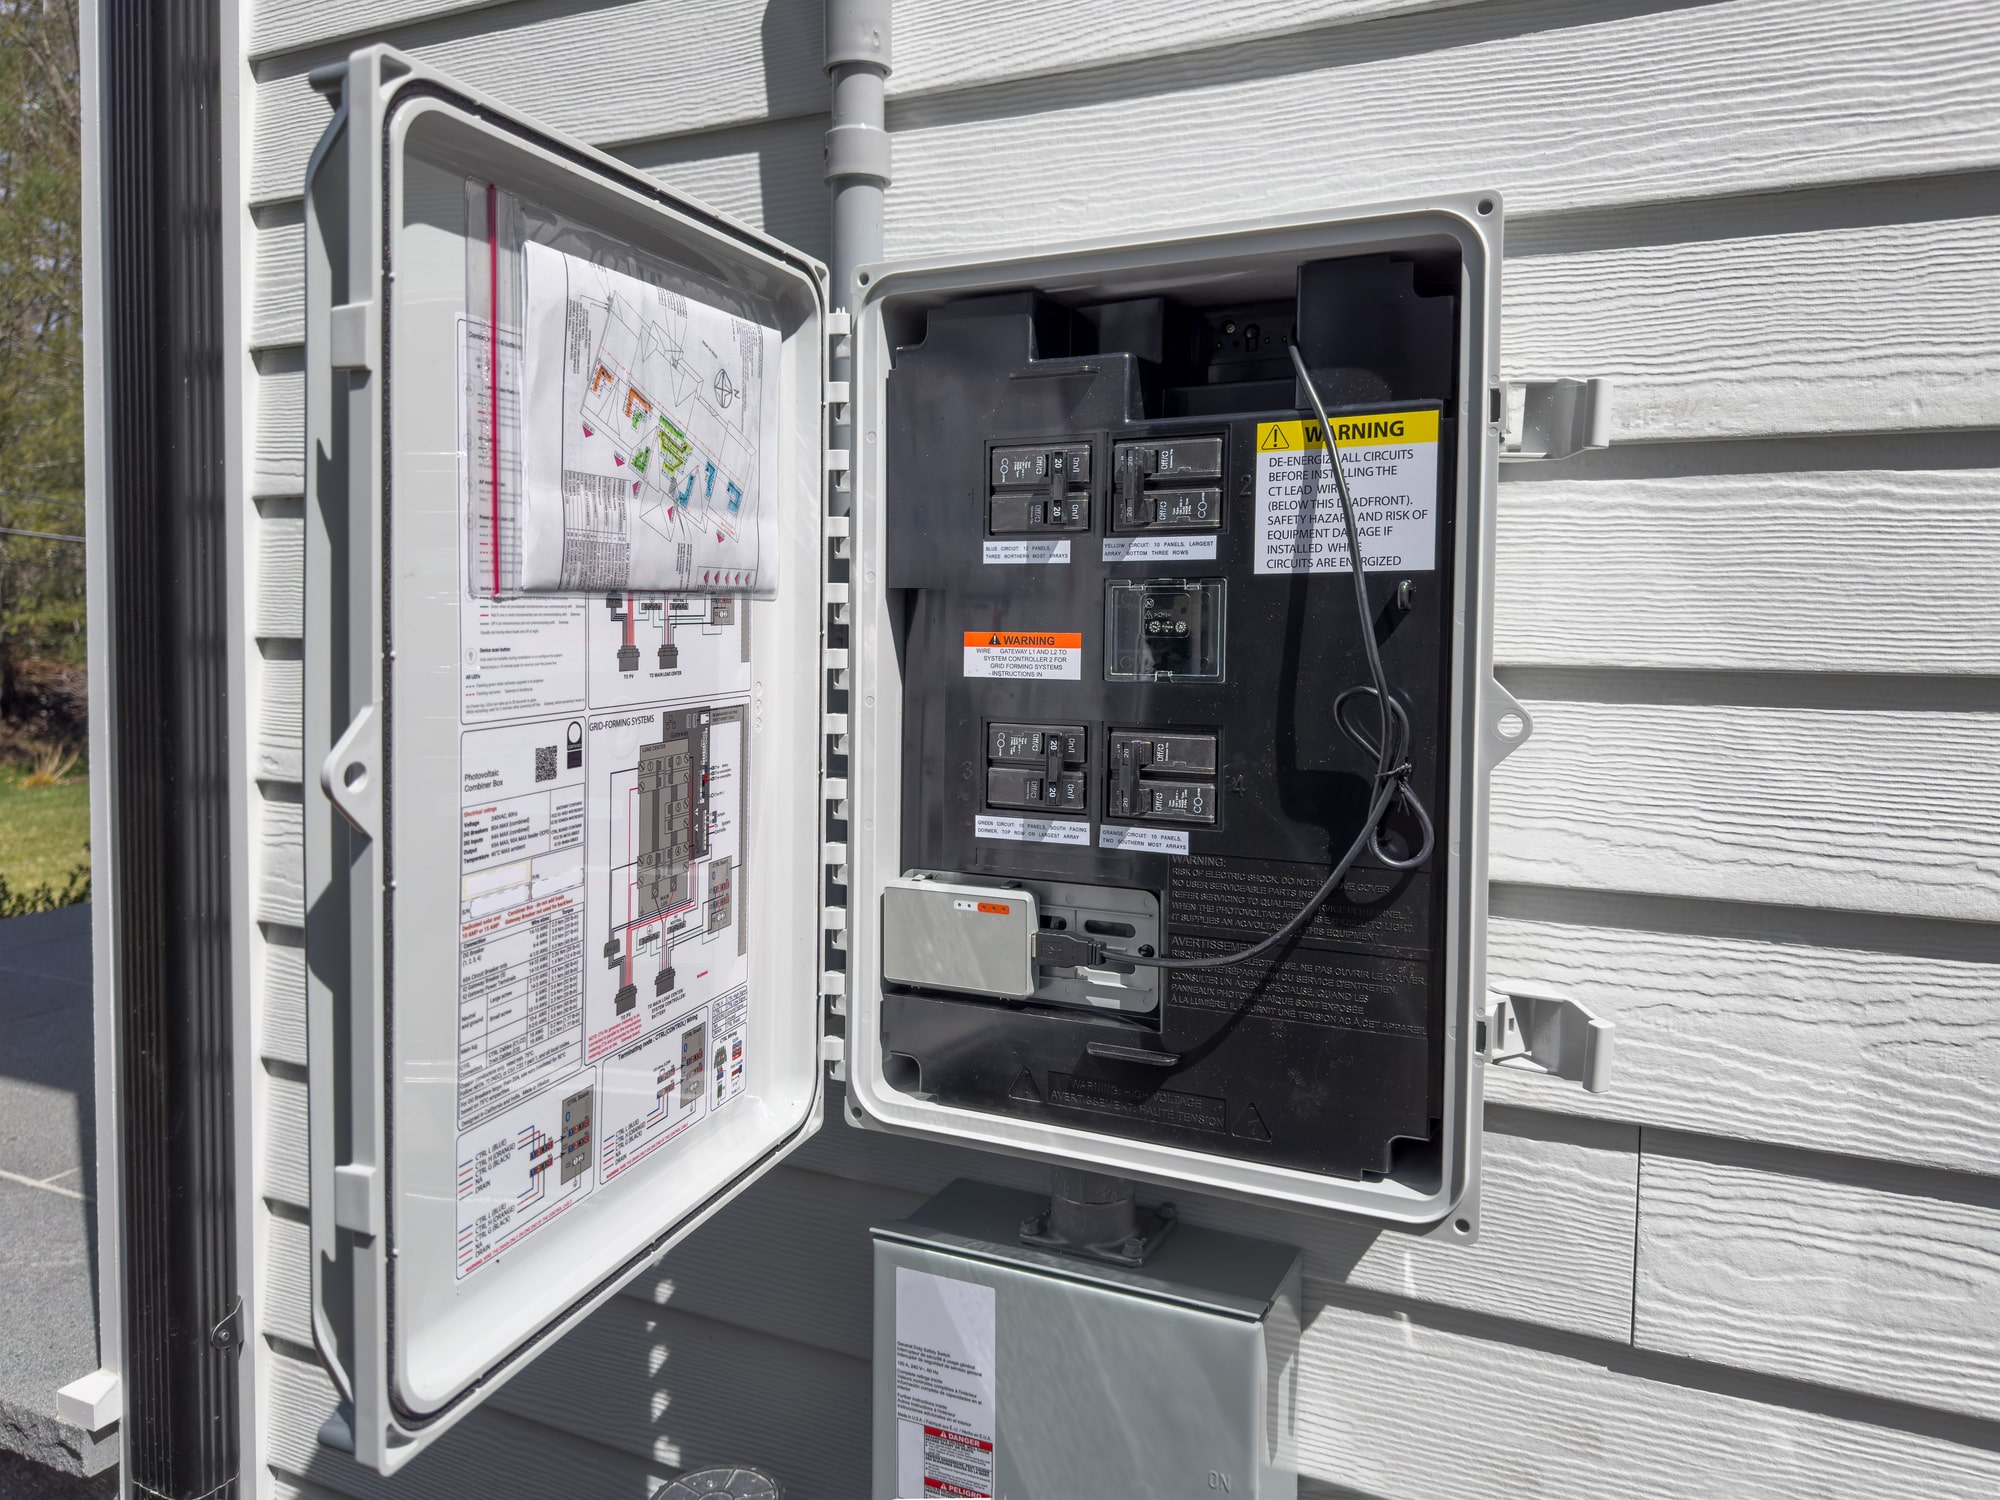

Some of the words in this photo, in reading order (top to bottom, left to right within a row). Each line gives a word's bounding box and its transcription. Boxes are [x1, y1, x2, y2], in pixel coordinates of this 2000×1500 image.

[1054, 458, 1062, 468] 20
[1128, 456, 1133, 466] 20
[1269, 454, 1331, 467] DE-ENERGIZ
[1341, 453, 1361, 463] ALL
[1363, 449, 1414, 462] CIRCUITS
[1268, 471, 1308, 482] BEFORE
[1311, 467, 1374, 480] INSTLLING
[1376, 465, 1398, 475] THE
[1268, 486, 1283, 496] CT
[1284, 485, 1312, 496] LEAD
[1317, 483, 1350, 494] WIRS
[1053, 506, 1061, 517] 20
[1268, 500, 1308, 512] (BELOW
[1310, 498, 1334, 509] THIS
[1127, 507, 1132, 517] 20
[1268, 514, 1306, 525] SAFETY
[1358, 511, 1383, 522] AND
[1385, 510, 1410, 521] RISK
[1412, 509, 1428, 520] OF
[1267, 528, 1330, 540] EQUIPMENT
[1383, 526, 1394, 536] IF
[1267, 543, 1323, 554] INSTALLED
[1267, 558, 1314, 569] CIRCUITS
[1316, 557, 1337, 568] ARE
[1339, 556, 1401, 567] ENRGIZED
[1004, 636, 1055, 646] WARNING
[590, 718, 630, 731] GRID-FORMING
[632, 714, 654, 726] SYSTEMS
[1050, 740, 1058, 750] 20
[1123, 748, 1129, 758] 20
[464, 769, 499, 782] Photovoltaic
[464, 781, 491, 792] Combiner
[493, 779, 503, 787] Box
[1049, 787, 1056, 798] 20
[1123, 797, 1128, 807] 20
[1172, 855, 1226, 868] WARNING:
[1172, 868, 1191, 877] RISK
[1192, 869, 1204, 877] OF
[1206, 870, 1246, 881] ELECTRIC
[1281, 877, 1294, 885] DO
[1296, 878, 1315, 887] NOT
[1172, 879, 1184, 887] NO
[1186, 880, 1208, 889] USER
[1210, 882, 1266, 894] SERVICEABLE
[1268, 887, 1296, 897] PARTS
[1172, 890, 1199, 900] REFER
[1200, 893, 1245, 904] SERVICING
[1247, 897, 1258, 905] TO
[1260, 898, 1305, 910] QUALIFIED
[1172, 902, 1196, 910] WHEN
[1198, 904, 1214, 913] THE
[1216, 906, 1280, 919] PHOTOVOLTAIC
[1370, 921, 1383, 929] TO
[1181, 914, 1219, 924] SUPPLIES
[1222, 918, 1232, 926] AN
[948, 1433, 980, 1447] DANGER
